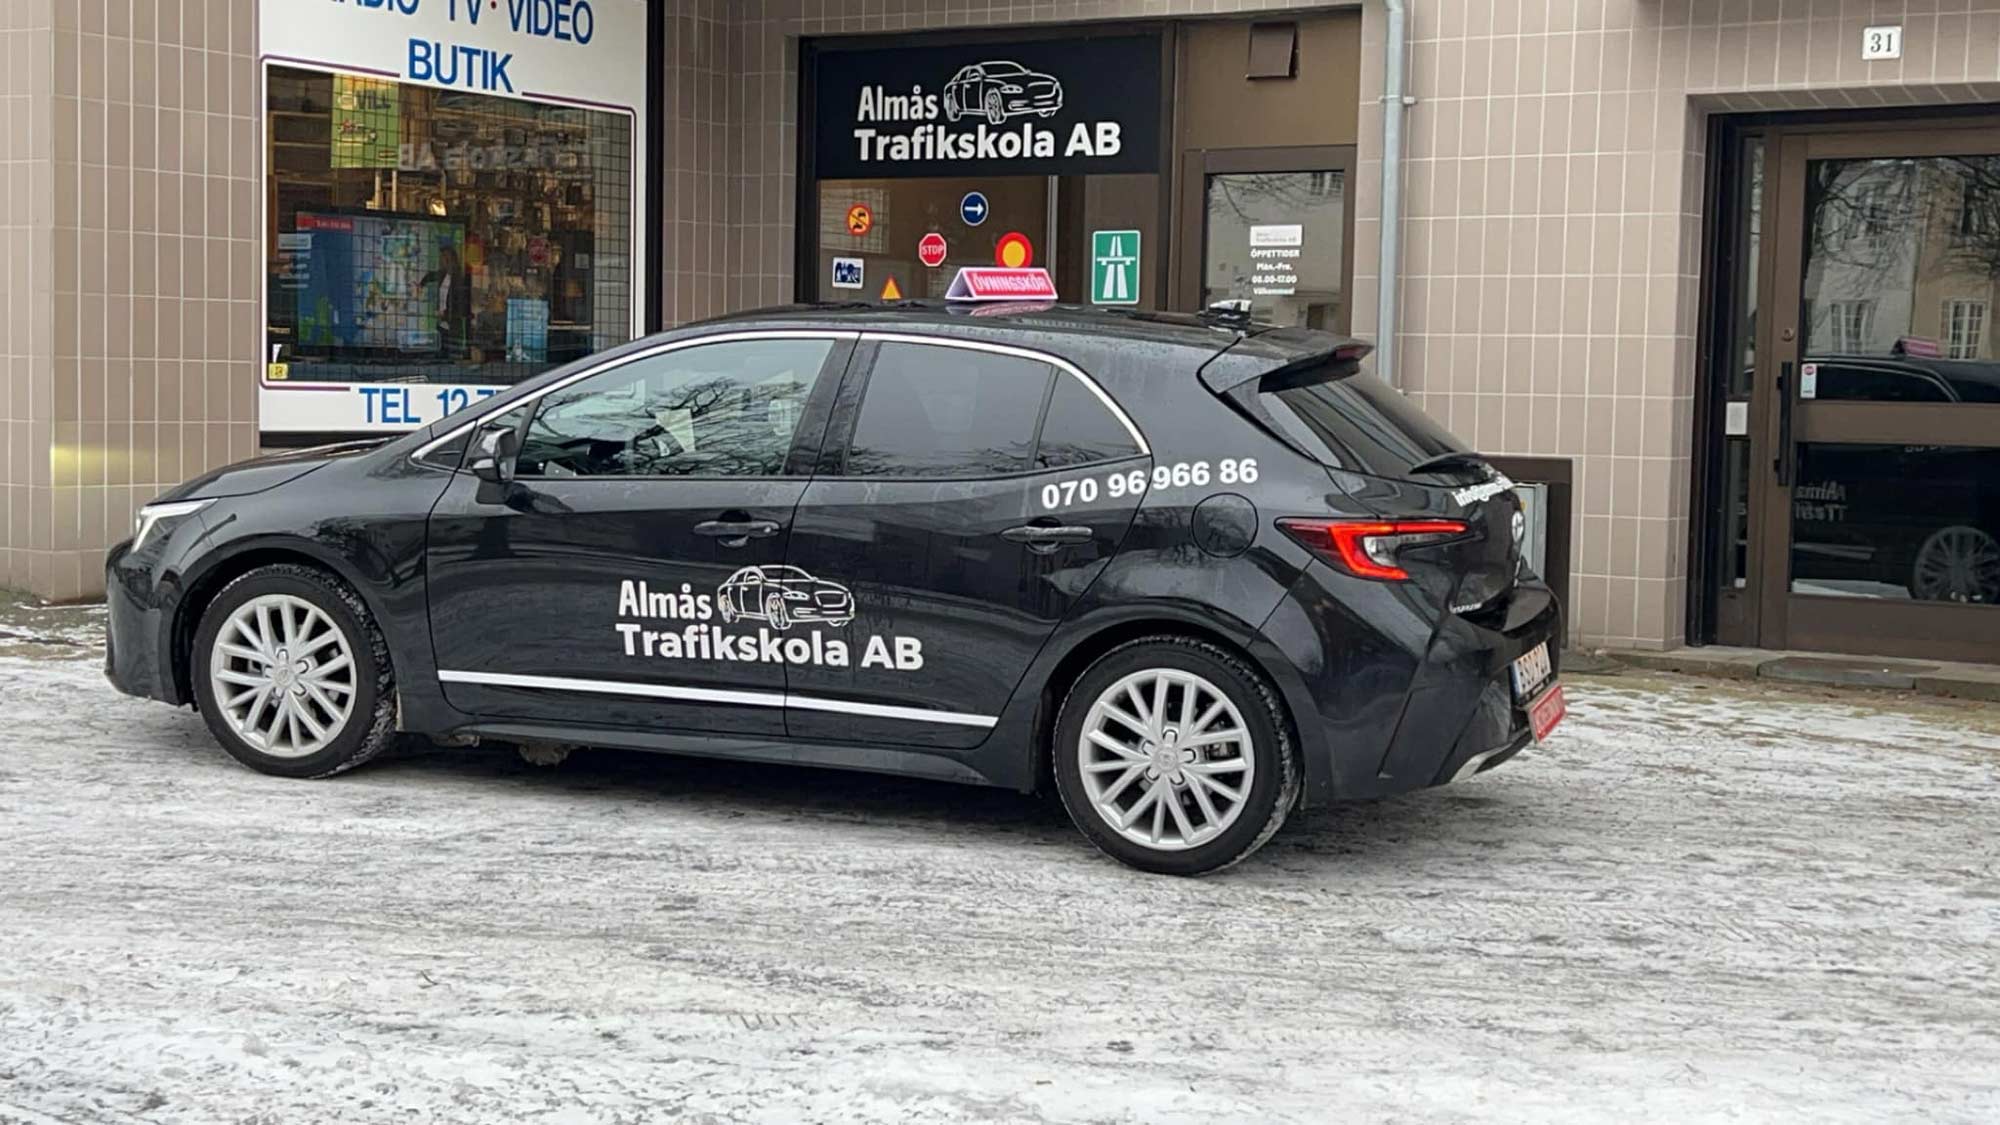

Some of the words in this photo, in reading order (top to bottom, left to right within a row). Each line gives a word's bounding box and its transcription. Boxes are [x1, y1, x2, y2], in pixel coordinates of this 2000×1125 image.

[507, 0, 594, 44] VIDEO
[1869, 32, 1892, 53] 31
[408, 38, 513, 93] BUTIK
[857, 85, 938, 121] Almås
[854, 124, 1055, 160] Trafikskola
[1064, 122, 1121, 157] AB
[922, 244, 944, 256] STOP
[972, 272, 1051, 292] ÖVNINGSKÖR
[359, 388, 421, 423] TEL
[1041, 478, 1098, 509] 070
[1107, 470, 1146, 497] 96
[1152, 461, 1210, 490] 966
[1219, 458, 1258, 484] 86
[618, 580, 712, 620] Almås
[615, 623, 850, 667] Trafikskola
[861, 635, 924, 671] AB
